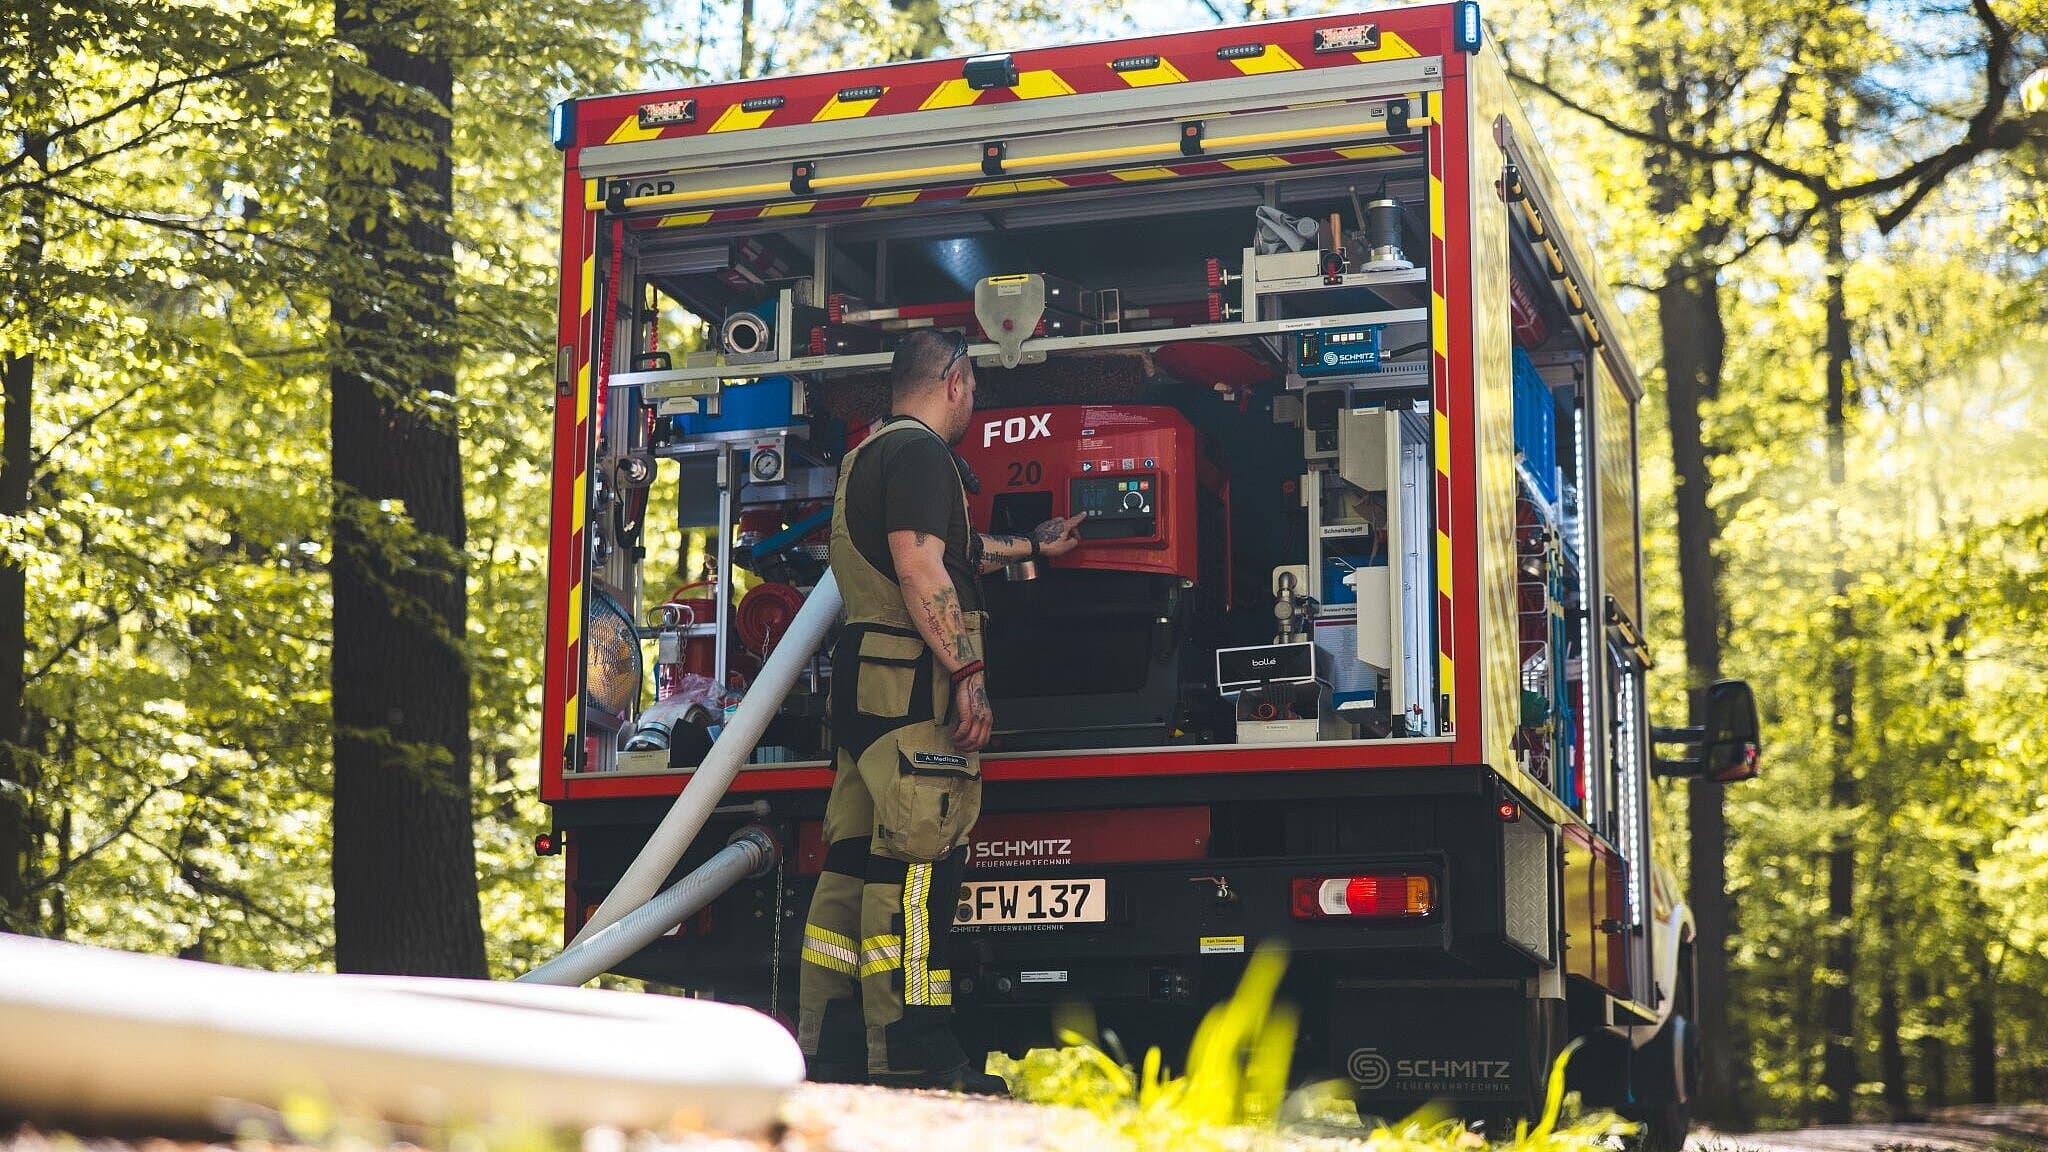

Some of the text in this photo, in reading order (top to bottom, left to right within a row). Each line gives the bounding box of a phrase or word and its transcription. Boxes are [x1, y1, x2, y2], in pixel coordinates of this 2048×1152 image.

[1340, 352, 1375, 361] SCHMITZ
[983, 413, 1052, 448] FOX
[1007, 460, 1042, 487] 20
[1323, 526, 1363, 534] Schnellangriff
[1251, 657, 1277, 667] bollé
[975, 839, 1071, 857] SCHMITZ
[976, 858, 1071, 868] FEUERWEHRTECHNIK
[976, 884, 1091, 920] FW 137
[988, 924, 1064, 933] FEUERWEHRTECHNIK
[1397, 1060, 1511, 1078] SCHMITZ
